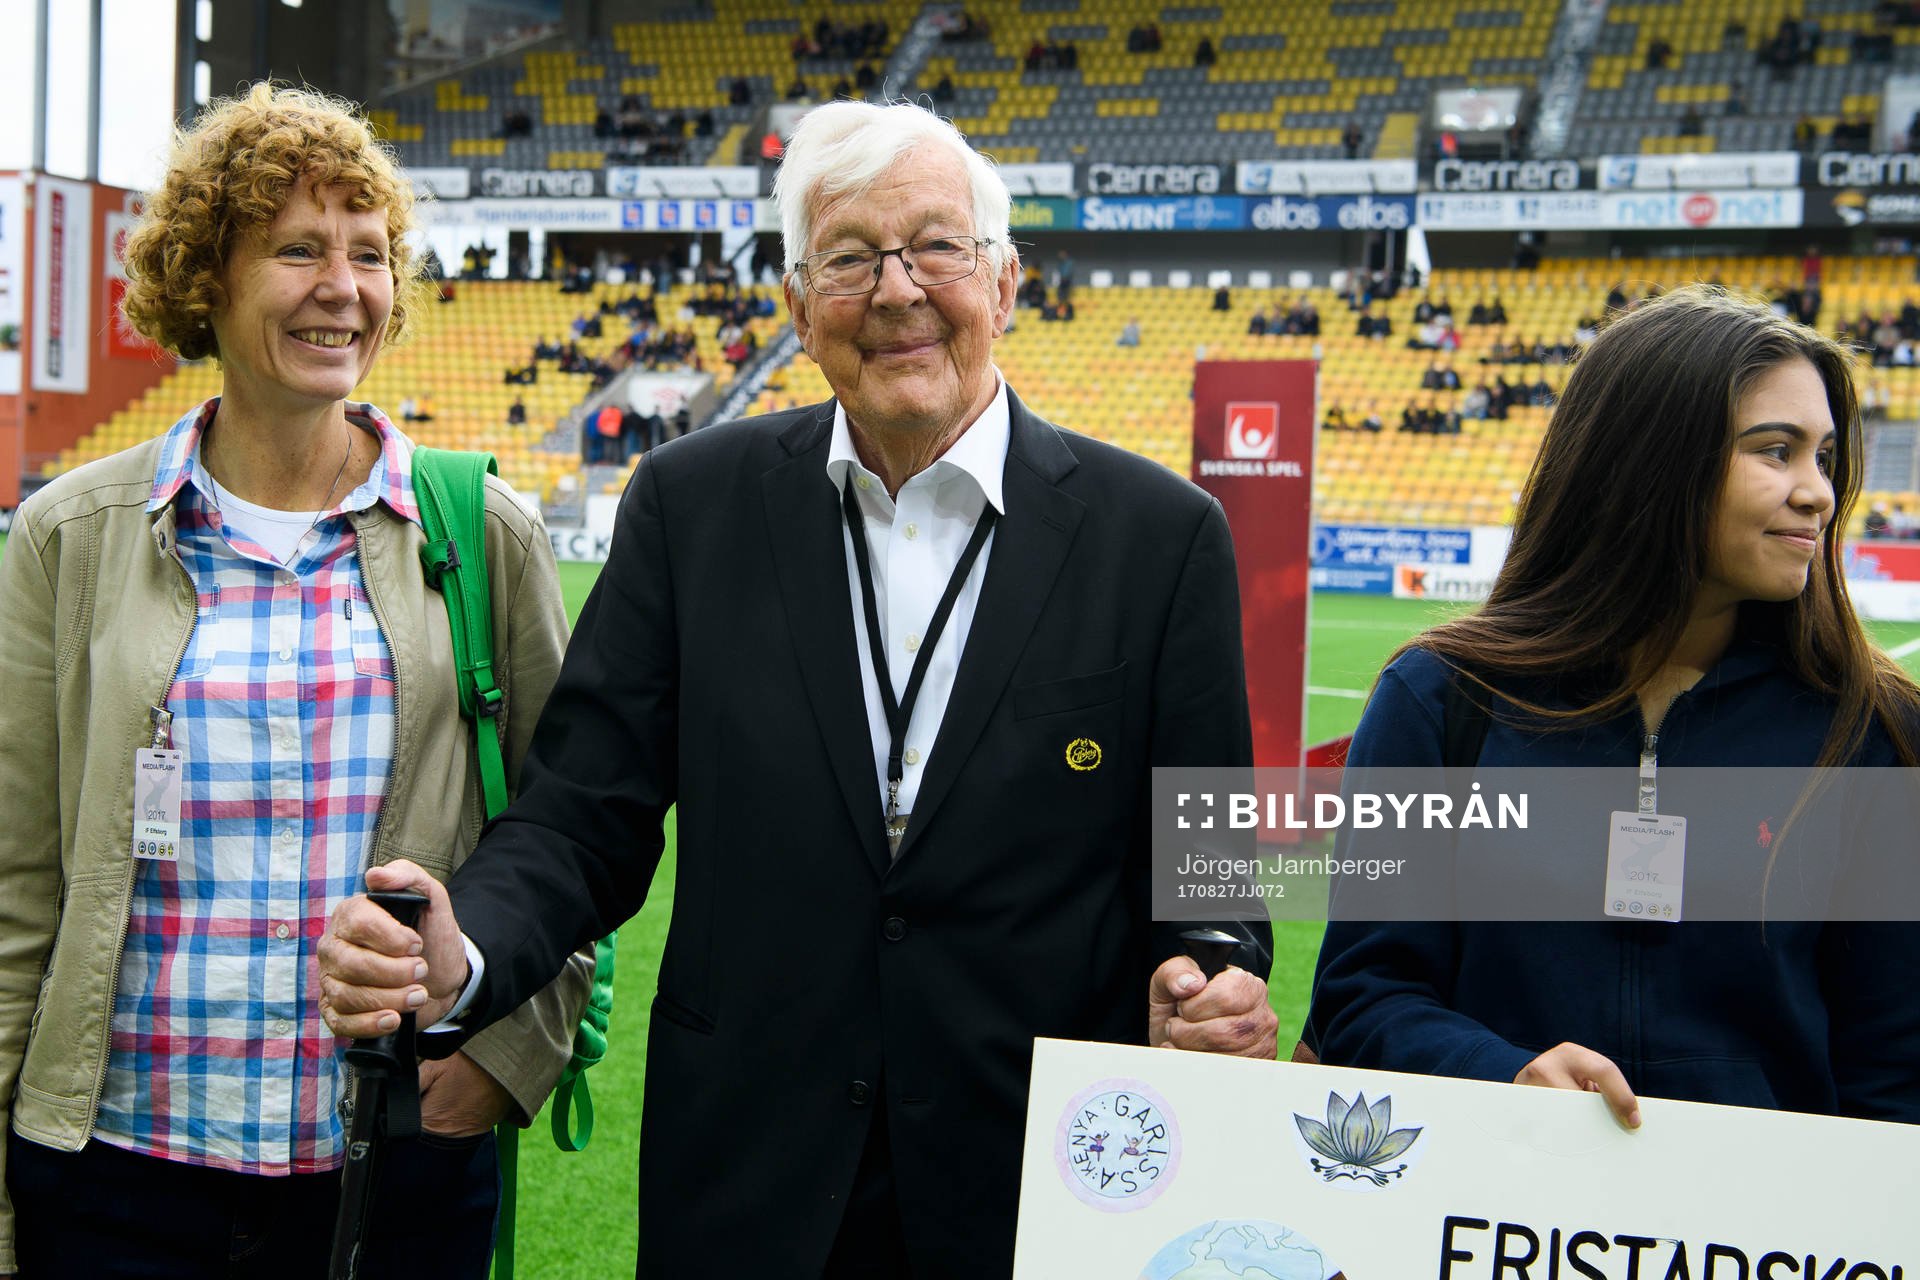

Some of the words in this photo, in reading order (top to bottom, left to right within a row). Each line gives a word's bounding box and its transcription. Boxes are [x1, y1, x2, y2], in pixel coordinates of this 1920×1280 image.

[1199, 459, 1265, 477] SVENSKA
[1266, 461, 1303, 478] SPEL
[142, 763, 176, 772] MEDIA/FLASH
[147, 810, 166, 821] 2017
[1620, 825, 1676, 837] MEDIA/FLASH
[1630, 870, 1660, 883] 2017
[1439, 1215, 1904, 1280] FRISTAD
